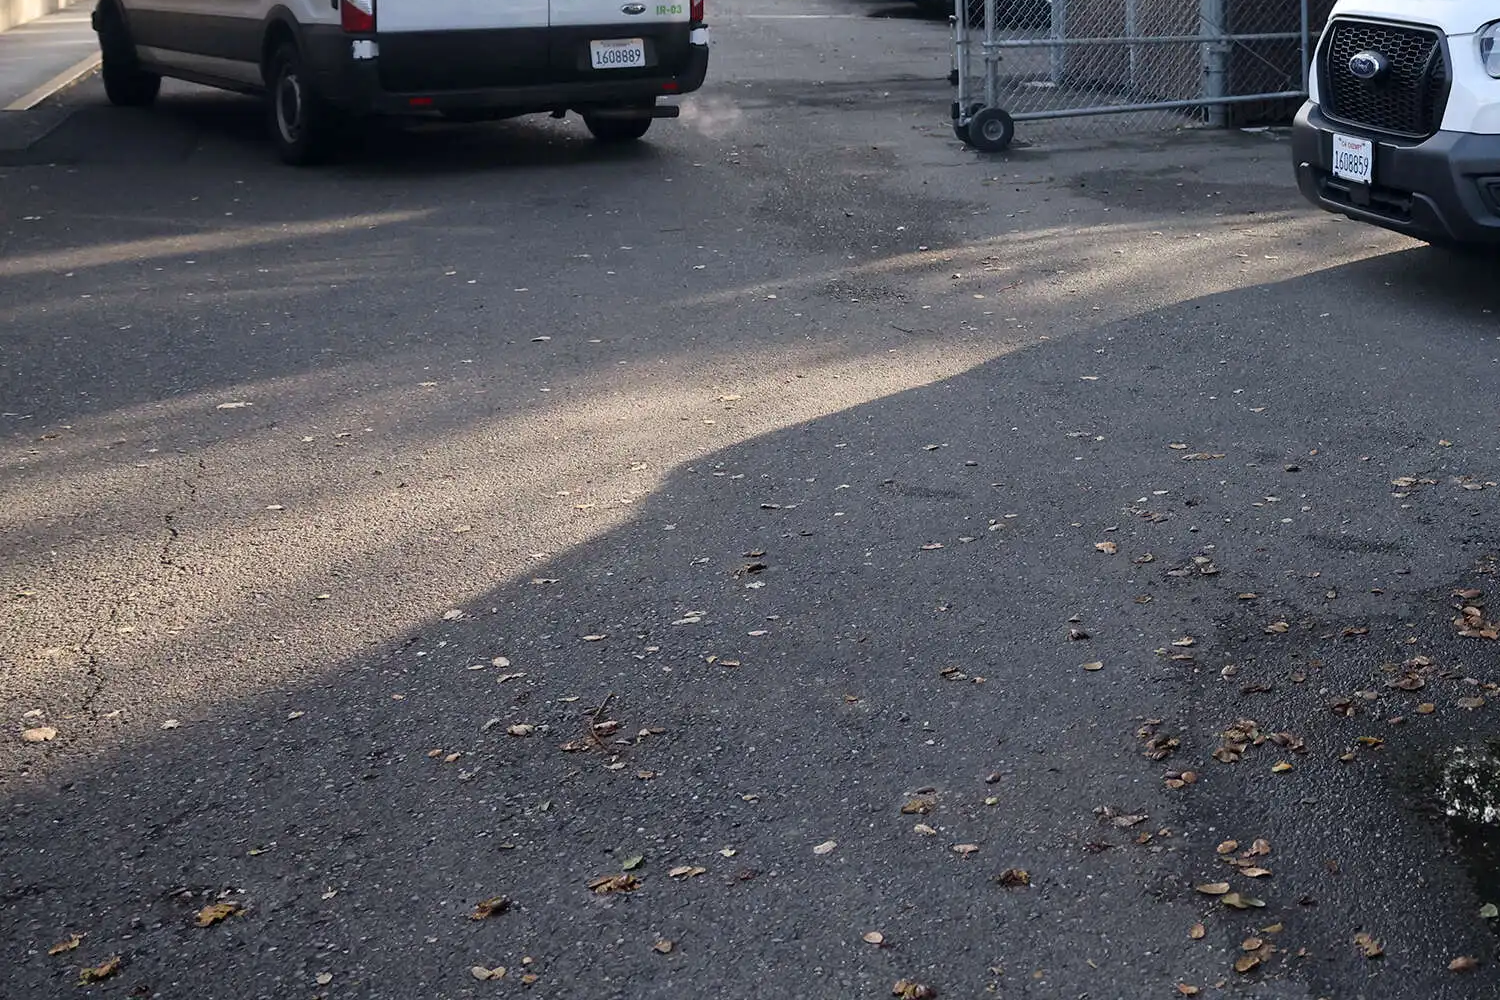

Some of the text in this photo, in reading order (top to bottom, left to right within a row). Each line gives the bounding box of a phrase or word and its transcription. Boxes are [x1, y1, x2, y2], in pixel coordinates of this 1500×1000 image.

[656, 5, 682, 15] IR-03
[596, 49, 641, 64] 1608889
[1335, 151, 1369, 176] 1608859
